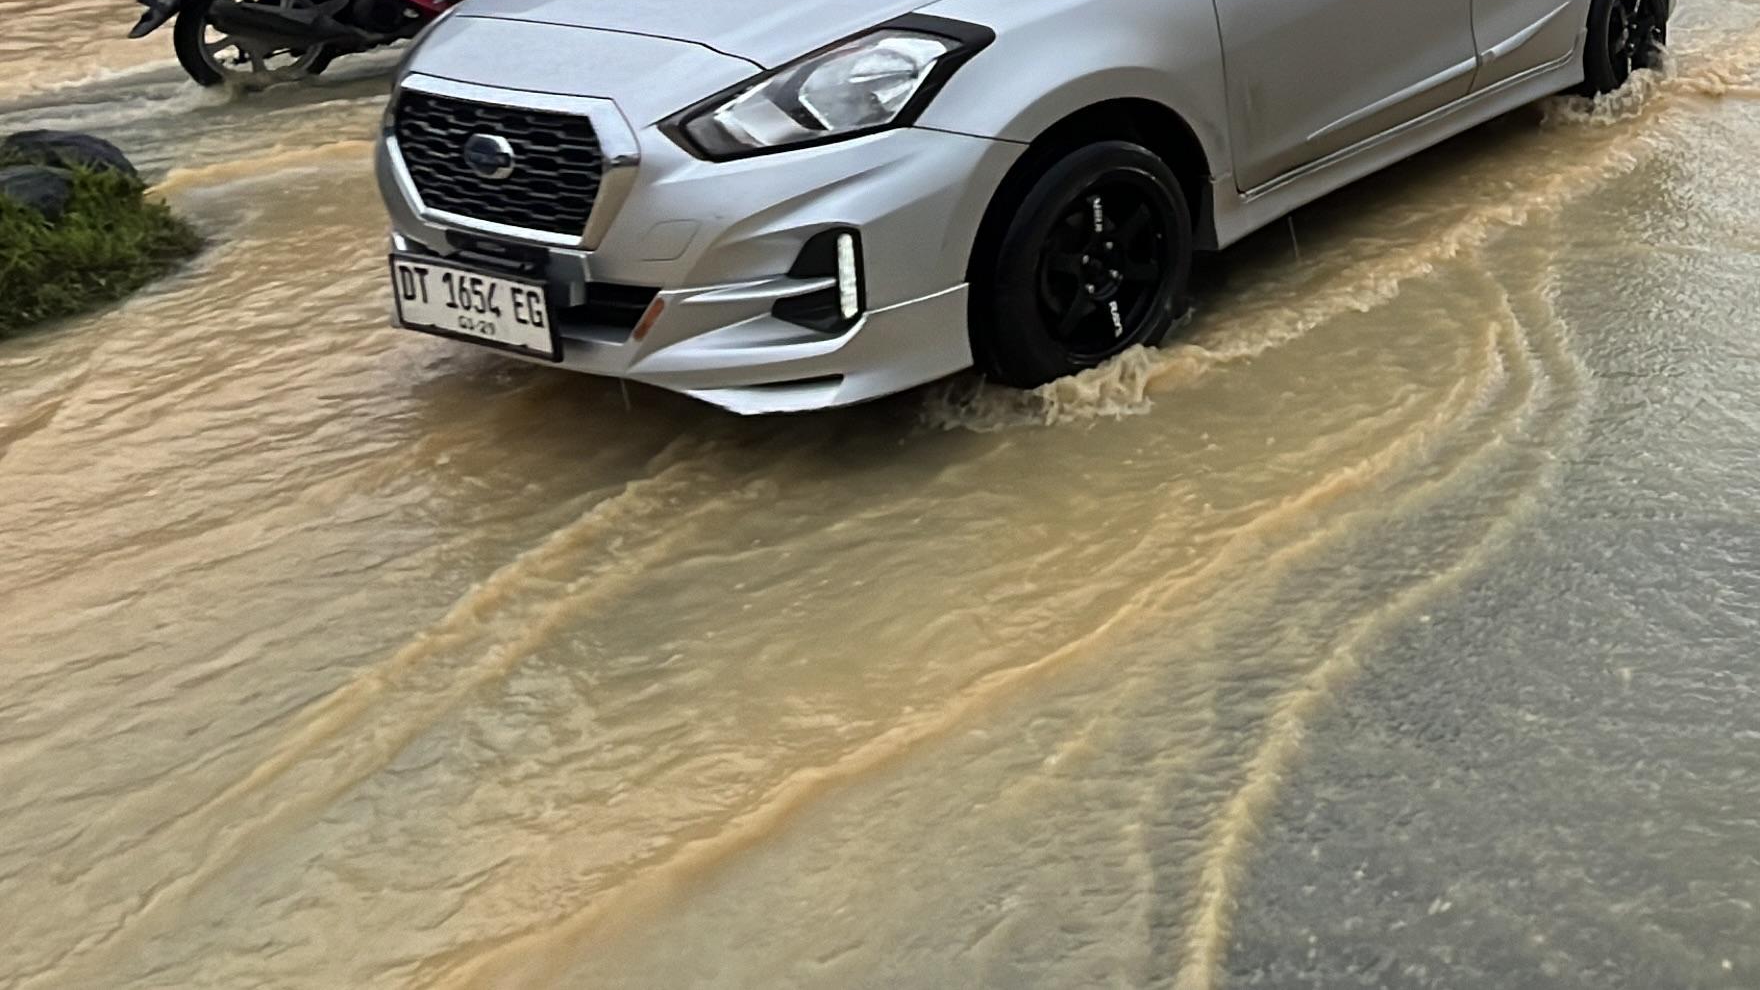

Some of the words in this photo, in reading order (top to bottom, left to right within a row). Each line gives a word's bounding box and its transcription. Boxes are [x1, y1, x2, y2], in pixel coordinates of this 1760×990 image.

[398, 265, 429, 304] DT
[442, 272, 501, 318] 1654
[510, 286, 545, 329] EG
